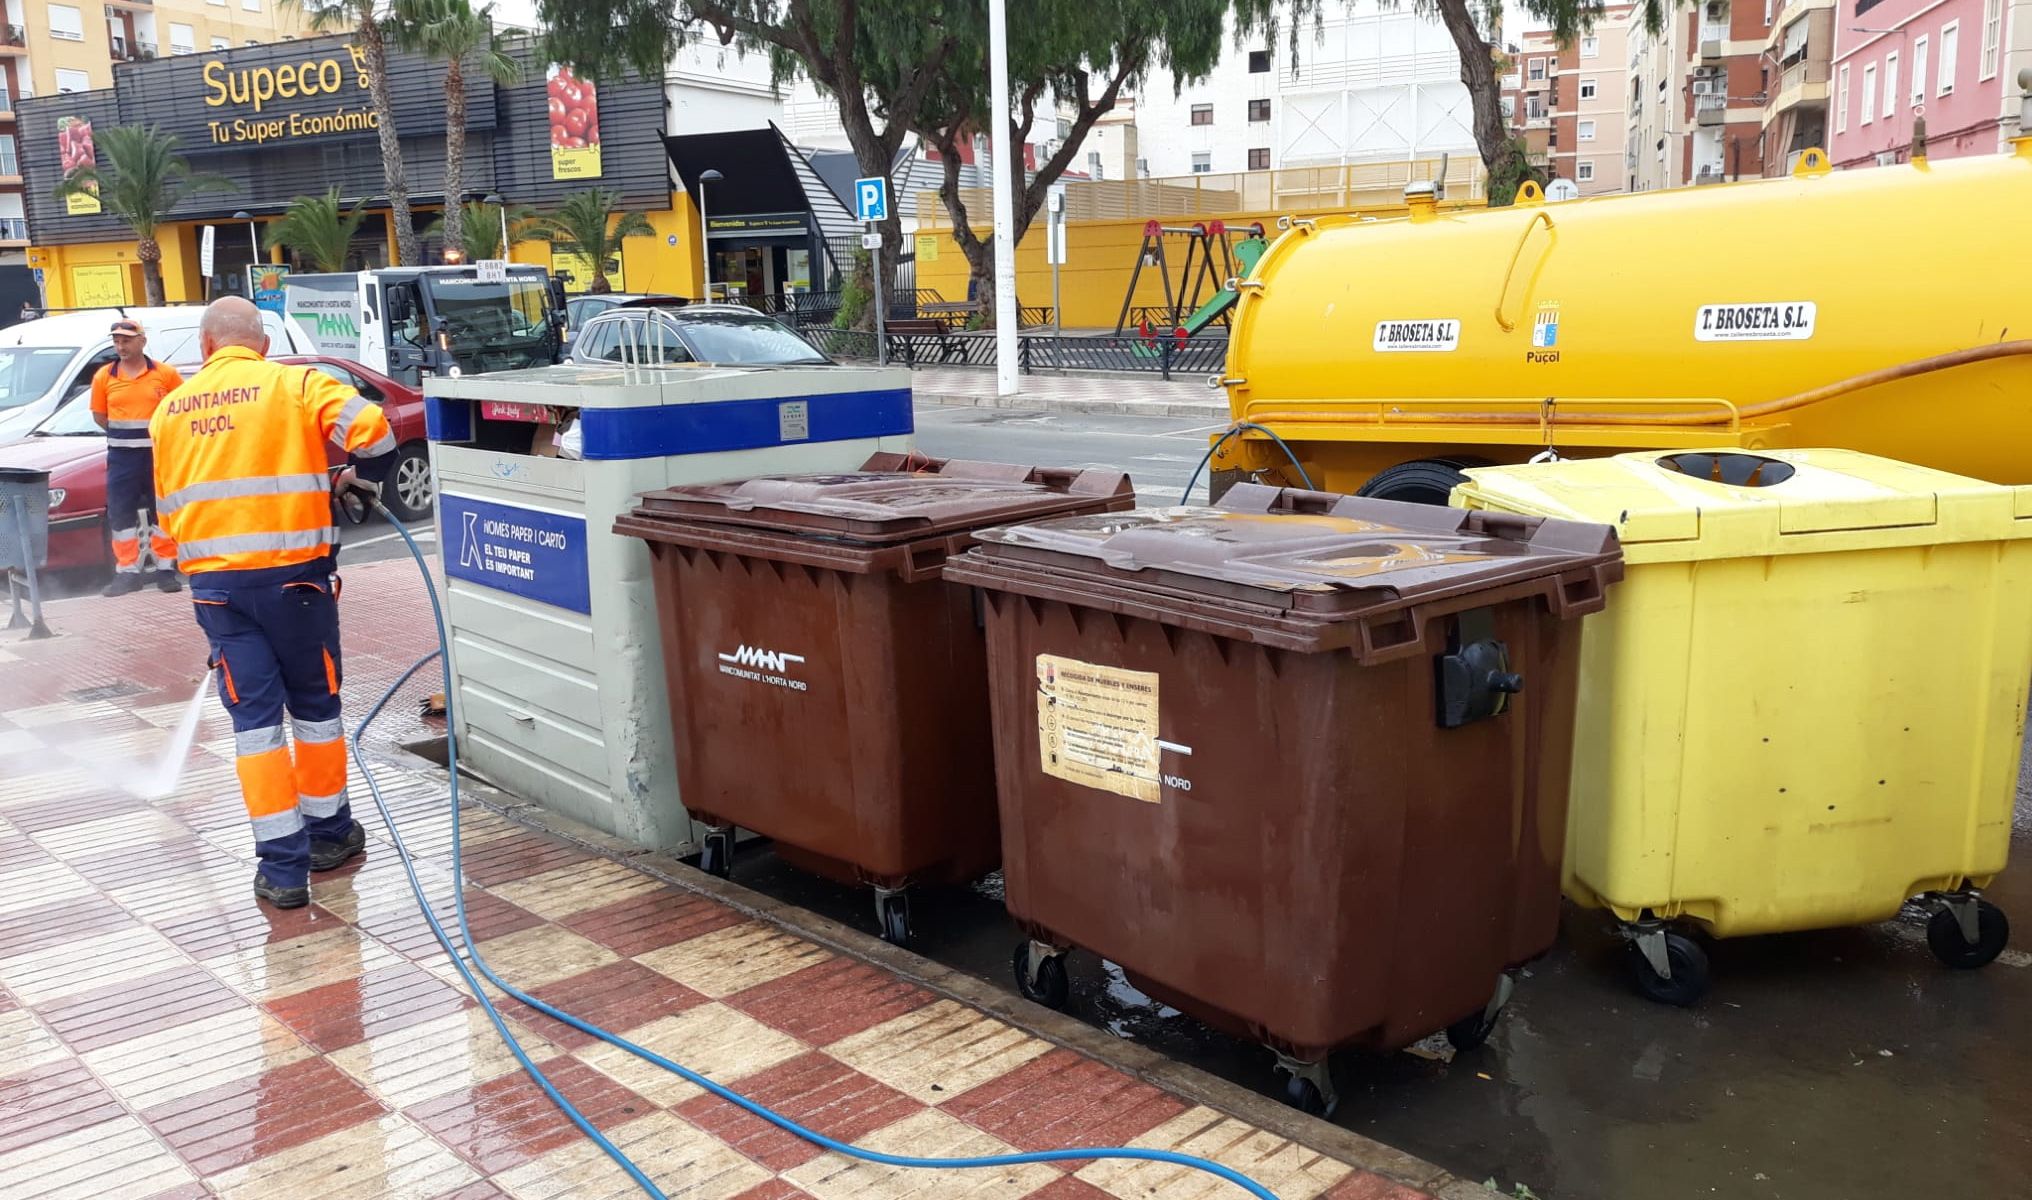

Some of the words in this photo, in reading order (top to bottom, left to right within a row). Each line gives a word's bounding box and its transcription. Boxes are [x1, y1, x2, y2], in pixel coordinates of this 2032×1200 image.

[203, 59, 342, 112] Supeco
[208, 121, 230, 144] Tu
[234, 118, 286, 144] Super
[290, 107, 380, 136] Económic
[861, 184, 879, 216] P
[1702, 308, 1712, 330] T.
[1715, 306, 1780, 330] BROSETA
[1783, 305, 1808, 329] S.L.
[1379, 324, 1387, 342] T.
[1388, 323, 1434, 342] BROSETA
[1436, 322, 1454, 342] S.L.
[1526, 350, 1560, 365] Puçol
[167, 386, 261, 416] AJUNTAMENT
[190, 415, 235, 437] PUÇOL
[483, 518, 509, 539] NOMÉS
[510, 523, 533, 543] PAPER
[538, 530, 567, 550] CARTÓ
[484, 543, 493, 555] EL
[494, 545, 508, 559] TEU
[508, 549, 531, 565] PAPER
[485, 557, 496, 570] ÉS
[495, 560, 535, 581] IMPORTANT
[788, 680, 807, 691] NORD
[1095, 677, 1121, 689] MUEBLES
[1126, 682, 1152, 693] ENSERES
[1164, 775, 1192, 791] NORD
